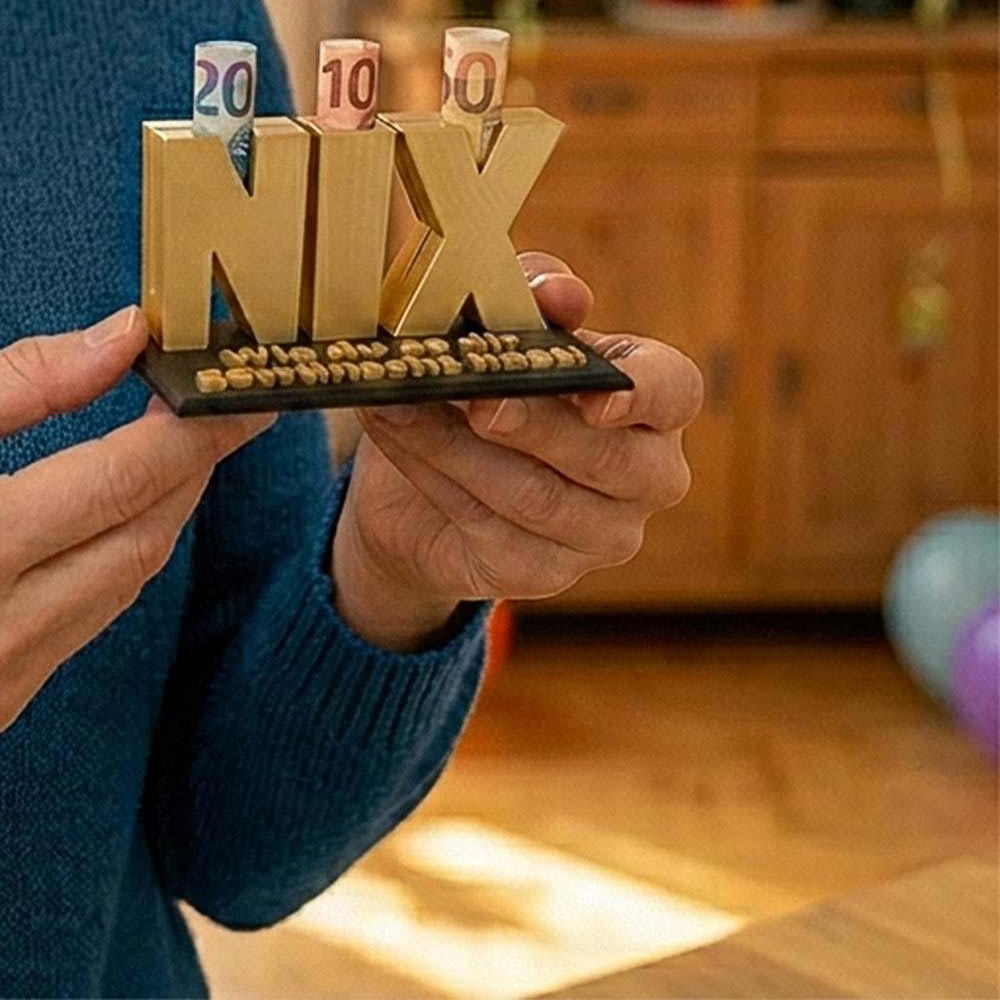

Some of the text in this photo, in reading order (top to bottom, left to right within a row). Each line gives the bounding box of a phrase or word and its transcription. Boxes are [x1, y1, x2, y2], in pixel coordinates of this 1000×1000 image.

[197, 60, 252, 118] 20
[322, 58, 376, 110] 10
[442, 52, 497, 114] 0
[143, 108, 566, 351] NIX
